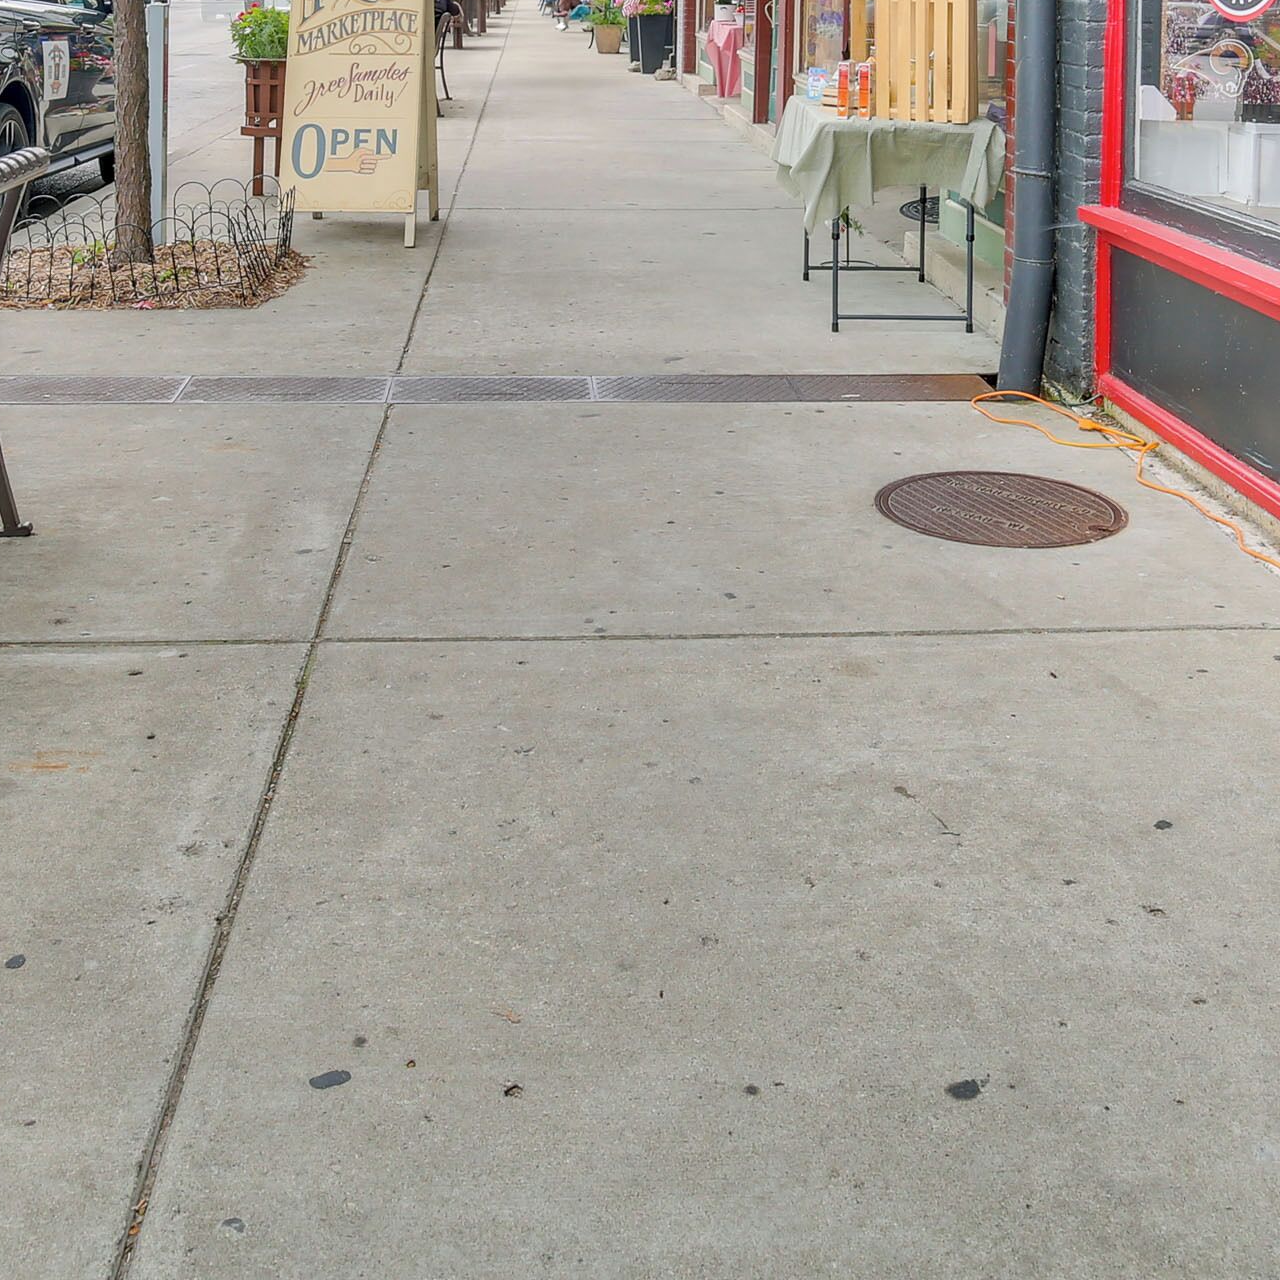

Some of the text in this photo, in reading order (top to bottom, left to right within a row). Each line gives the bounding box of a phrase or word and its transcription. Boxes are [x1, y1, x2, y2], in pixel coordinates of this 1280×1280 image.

[296, 10, 418, 53] MARKETPLACE
[294, 61, 414, 117] Free Samples
[291, 123, 398, 179] OPEN
